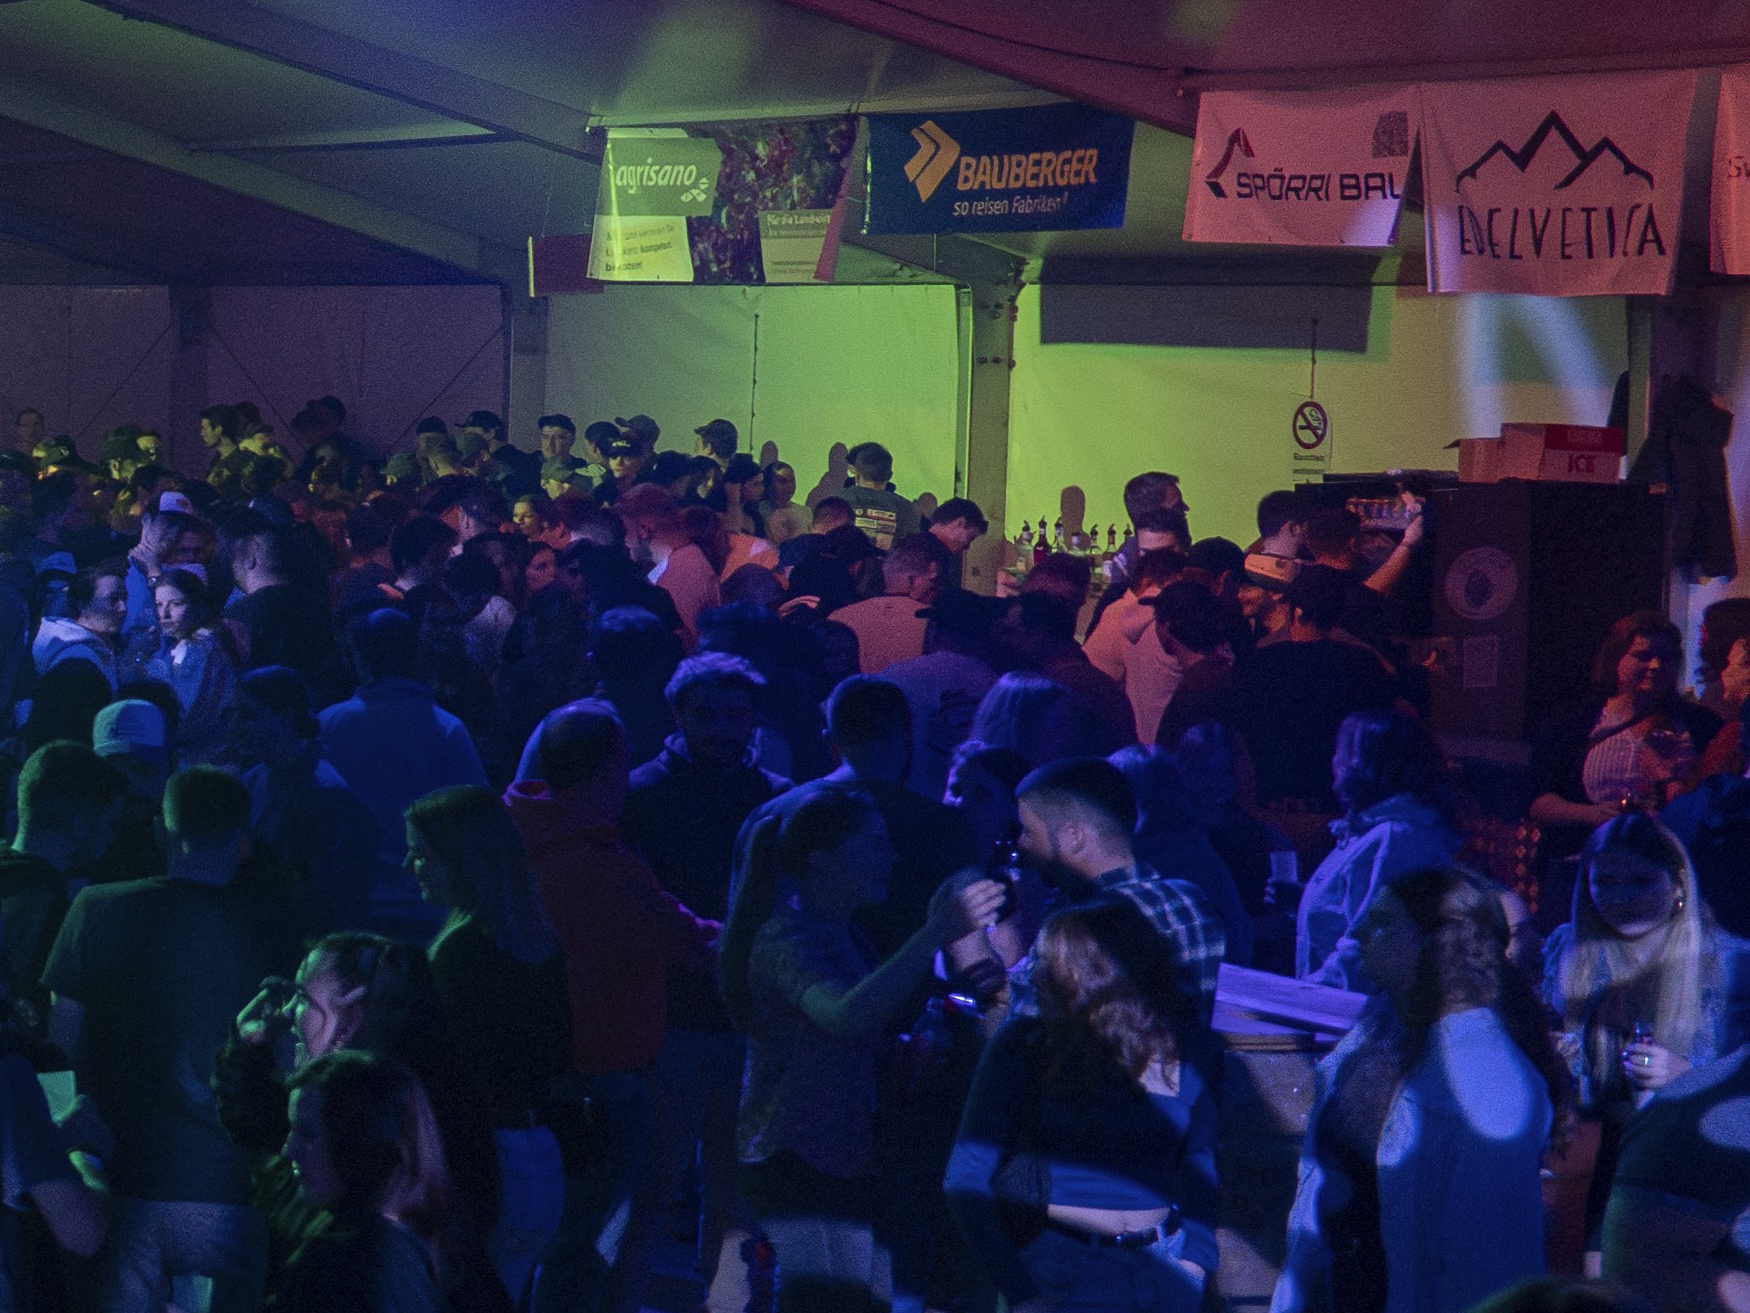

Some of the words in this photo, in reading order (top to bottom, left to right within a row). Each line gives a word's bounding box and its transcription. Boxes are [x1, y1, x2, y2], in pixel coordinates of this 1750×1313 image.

[614, 156, 698, 195] agrisano
[956, 147, 1099, 192] BAUBERGER
[1236, 167, 1331, 201] SPÖRRI
[952, 201, 970, 217] so
[971, 198, 1010, 216] reisen
